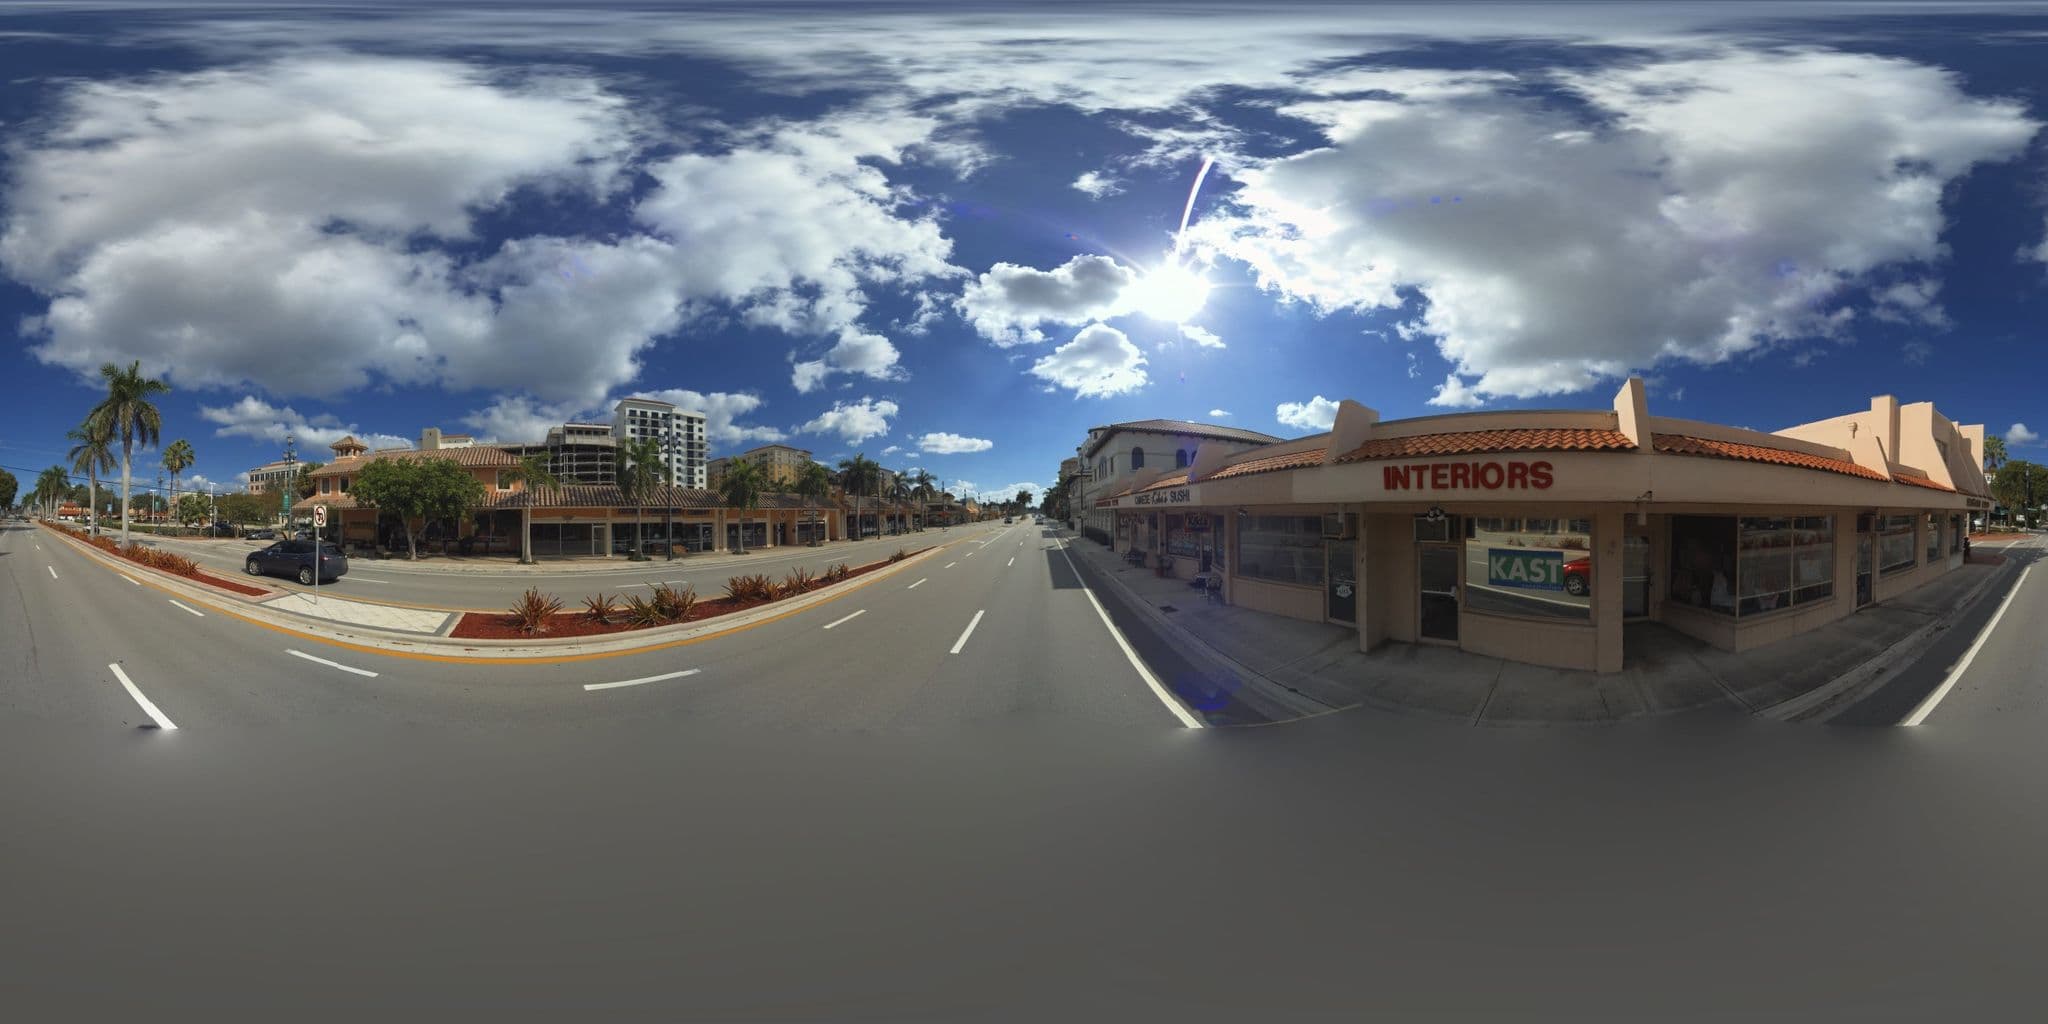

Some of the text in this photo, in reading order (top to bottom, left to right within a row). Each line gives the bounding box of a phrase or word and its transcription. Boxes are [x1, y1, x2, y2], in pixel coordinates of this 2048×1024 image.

[1383, 461, 1554, 490] INTERIORS
[1170, 489, 1190, 503] SUSHI
[1490, 555, 1562, 583] KAST
